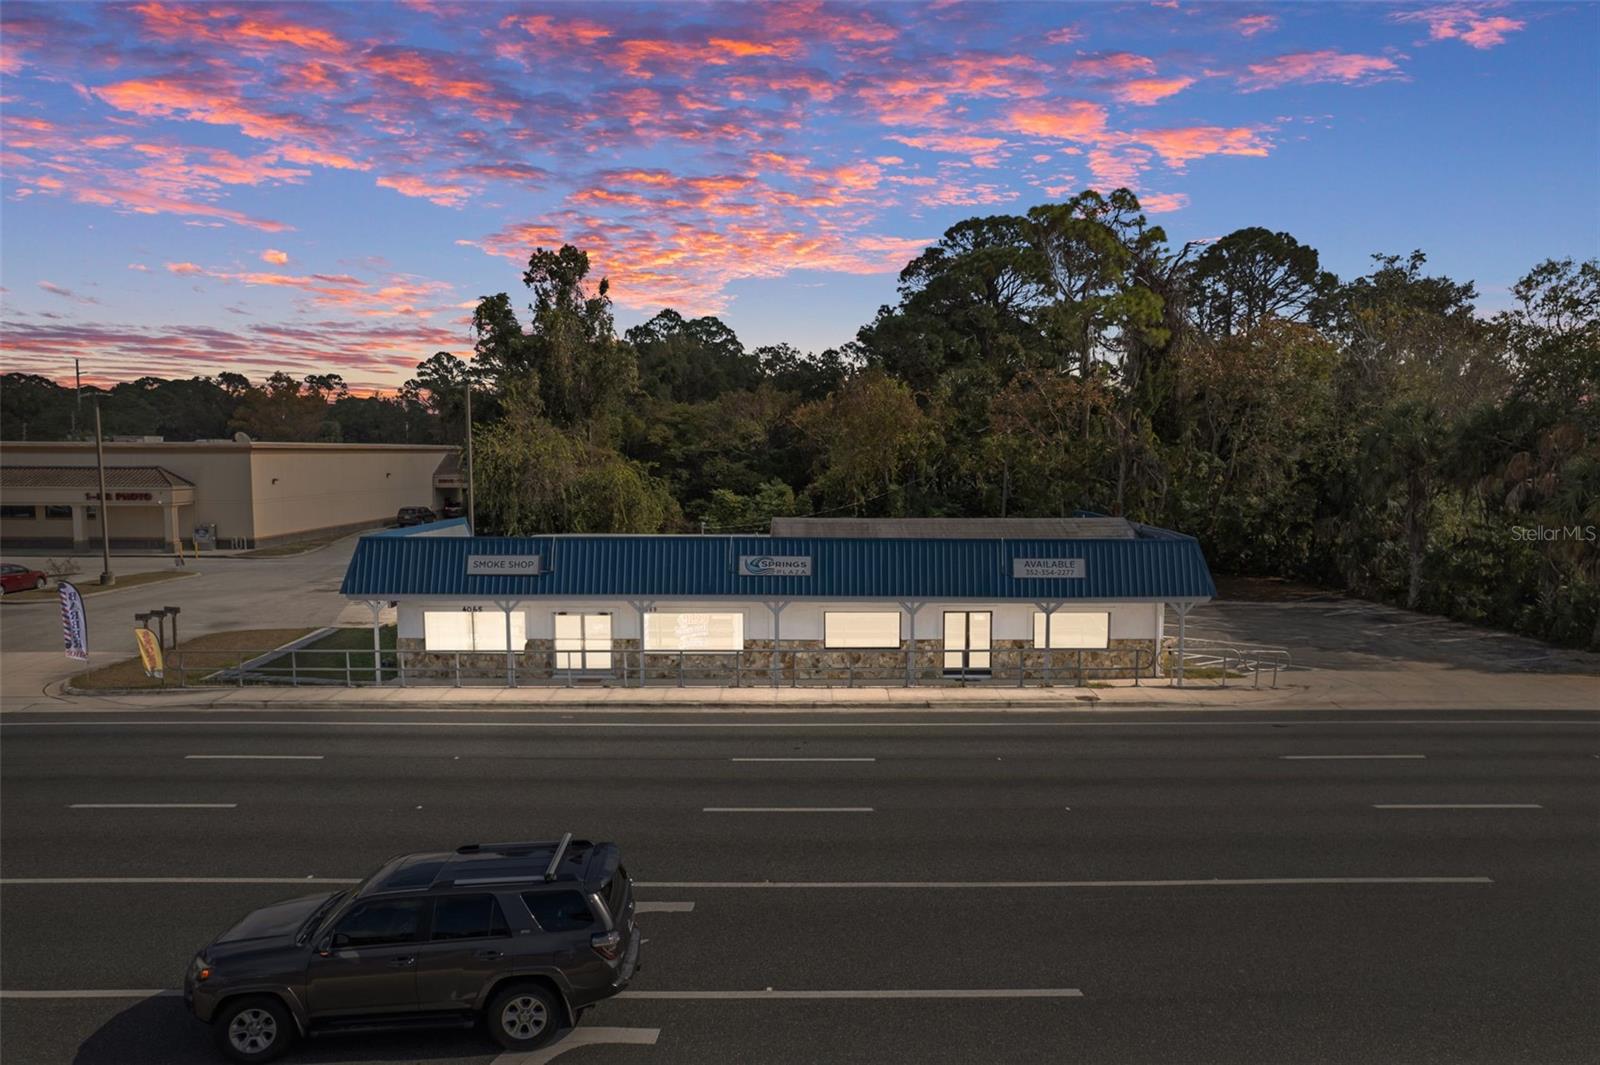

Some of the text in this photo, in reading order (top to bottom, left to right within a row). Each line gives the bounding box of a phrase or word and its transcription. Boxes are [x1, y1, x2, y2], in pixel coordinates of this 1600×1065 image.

[473, 560, 535, 569] SMOKE SHOP
[761, 560, 807, 568] SPRINGS
[1024, 560, 1076, 569] AVAILABLE
